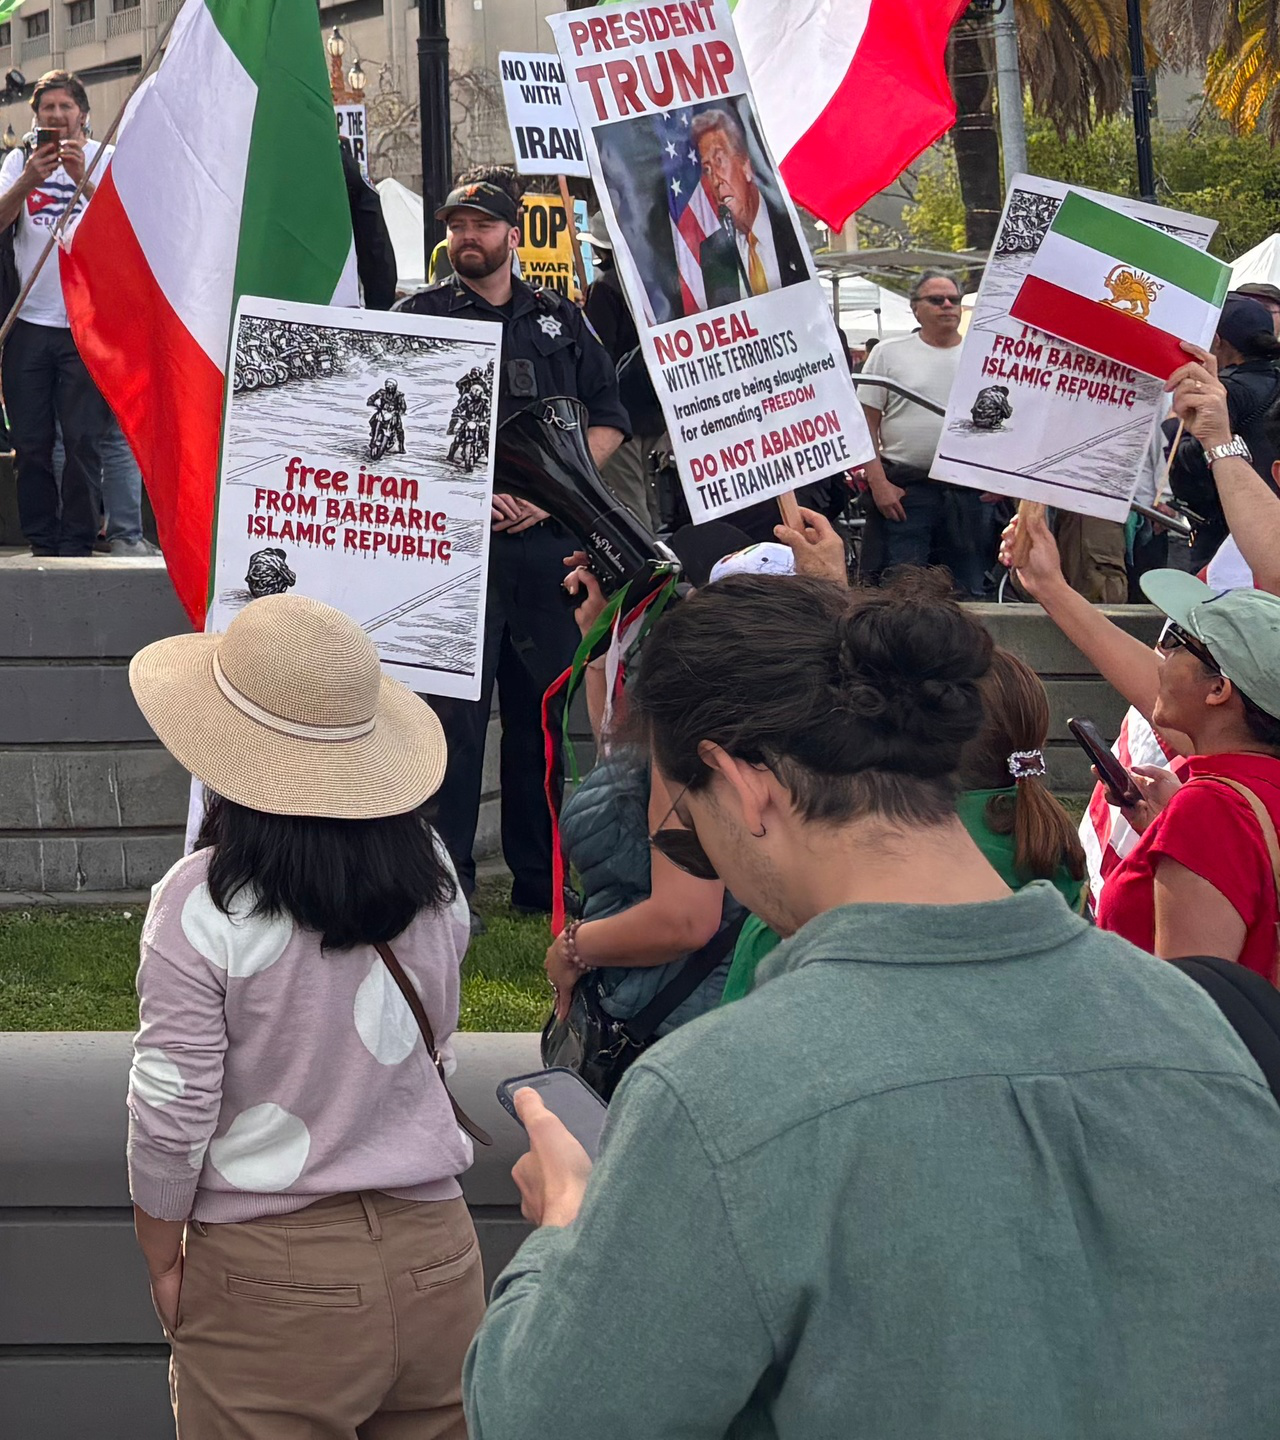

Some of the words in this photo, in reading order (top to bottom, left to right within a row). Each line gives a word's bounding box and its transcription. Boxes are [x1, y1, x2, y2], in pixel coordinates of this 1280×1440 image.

[501, 60, 527, 82] NO
[520, 85, 562, 105] WITH
[575, 40, 734, 121] TRUMP
[515, 127, 584, 161] IRAN
[530, 263, 568, 272] WAR
[653, 330, 693, 365] NO
[696, 310, 759, 353] DEAL
[663, 363, 700, 392] WITH
[697, 353, 725, 382] THE
[722, 330, 798, 377] TERRORISTS
[993, 335, 1043, 363] FROM
[1047, 348, 1137, 384] BARBARIC
[674, 395, 720, 420] Iranians
[722, 387, 741, 404] are
[743, 378, 772, 399] being
[773, 353, 835, 386] slaughtered
[982, 356, 1052, 389] ISLAMIC
[1056, 374, 1136, 407] REPUBLIC
[680, 425, 698, 442] for
[700, 404, 763, 437] demanding
[761, 384, 815, 415] FREEDOM
[690, 454, 717, 482] DO
[720, 439, 754, 472] NOT
[761, 410, 841, 458] ABANDON
[285, 457, 349, 494] free
[357, 466, 419, 502] iran
[697, 478, 731, 510] THE
[731, 453, 796, 499] IRANIAN
[794, 435, 850, 476] PEOPLE
[255, 488, 317, 517] FROM
[326, 498, 447, 533] BARBARIC
[247, 514, 336, 547] ISLAMIC
[344, 528, 451, 563] REPUBLIC
